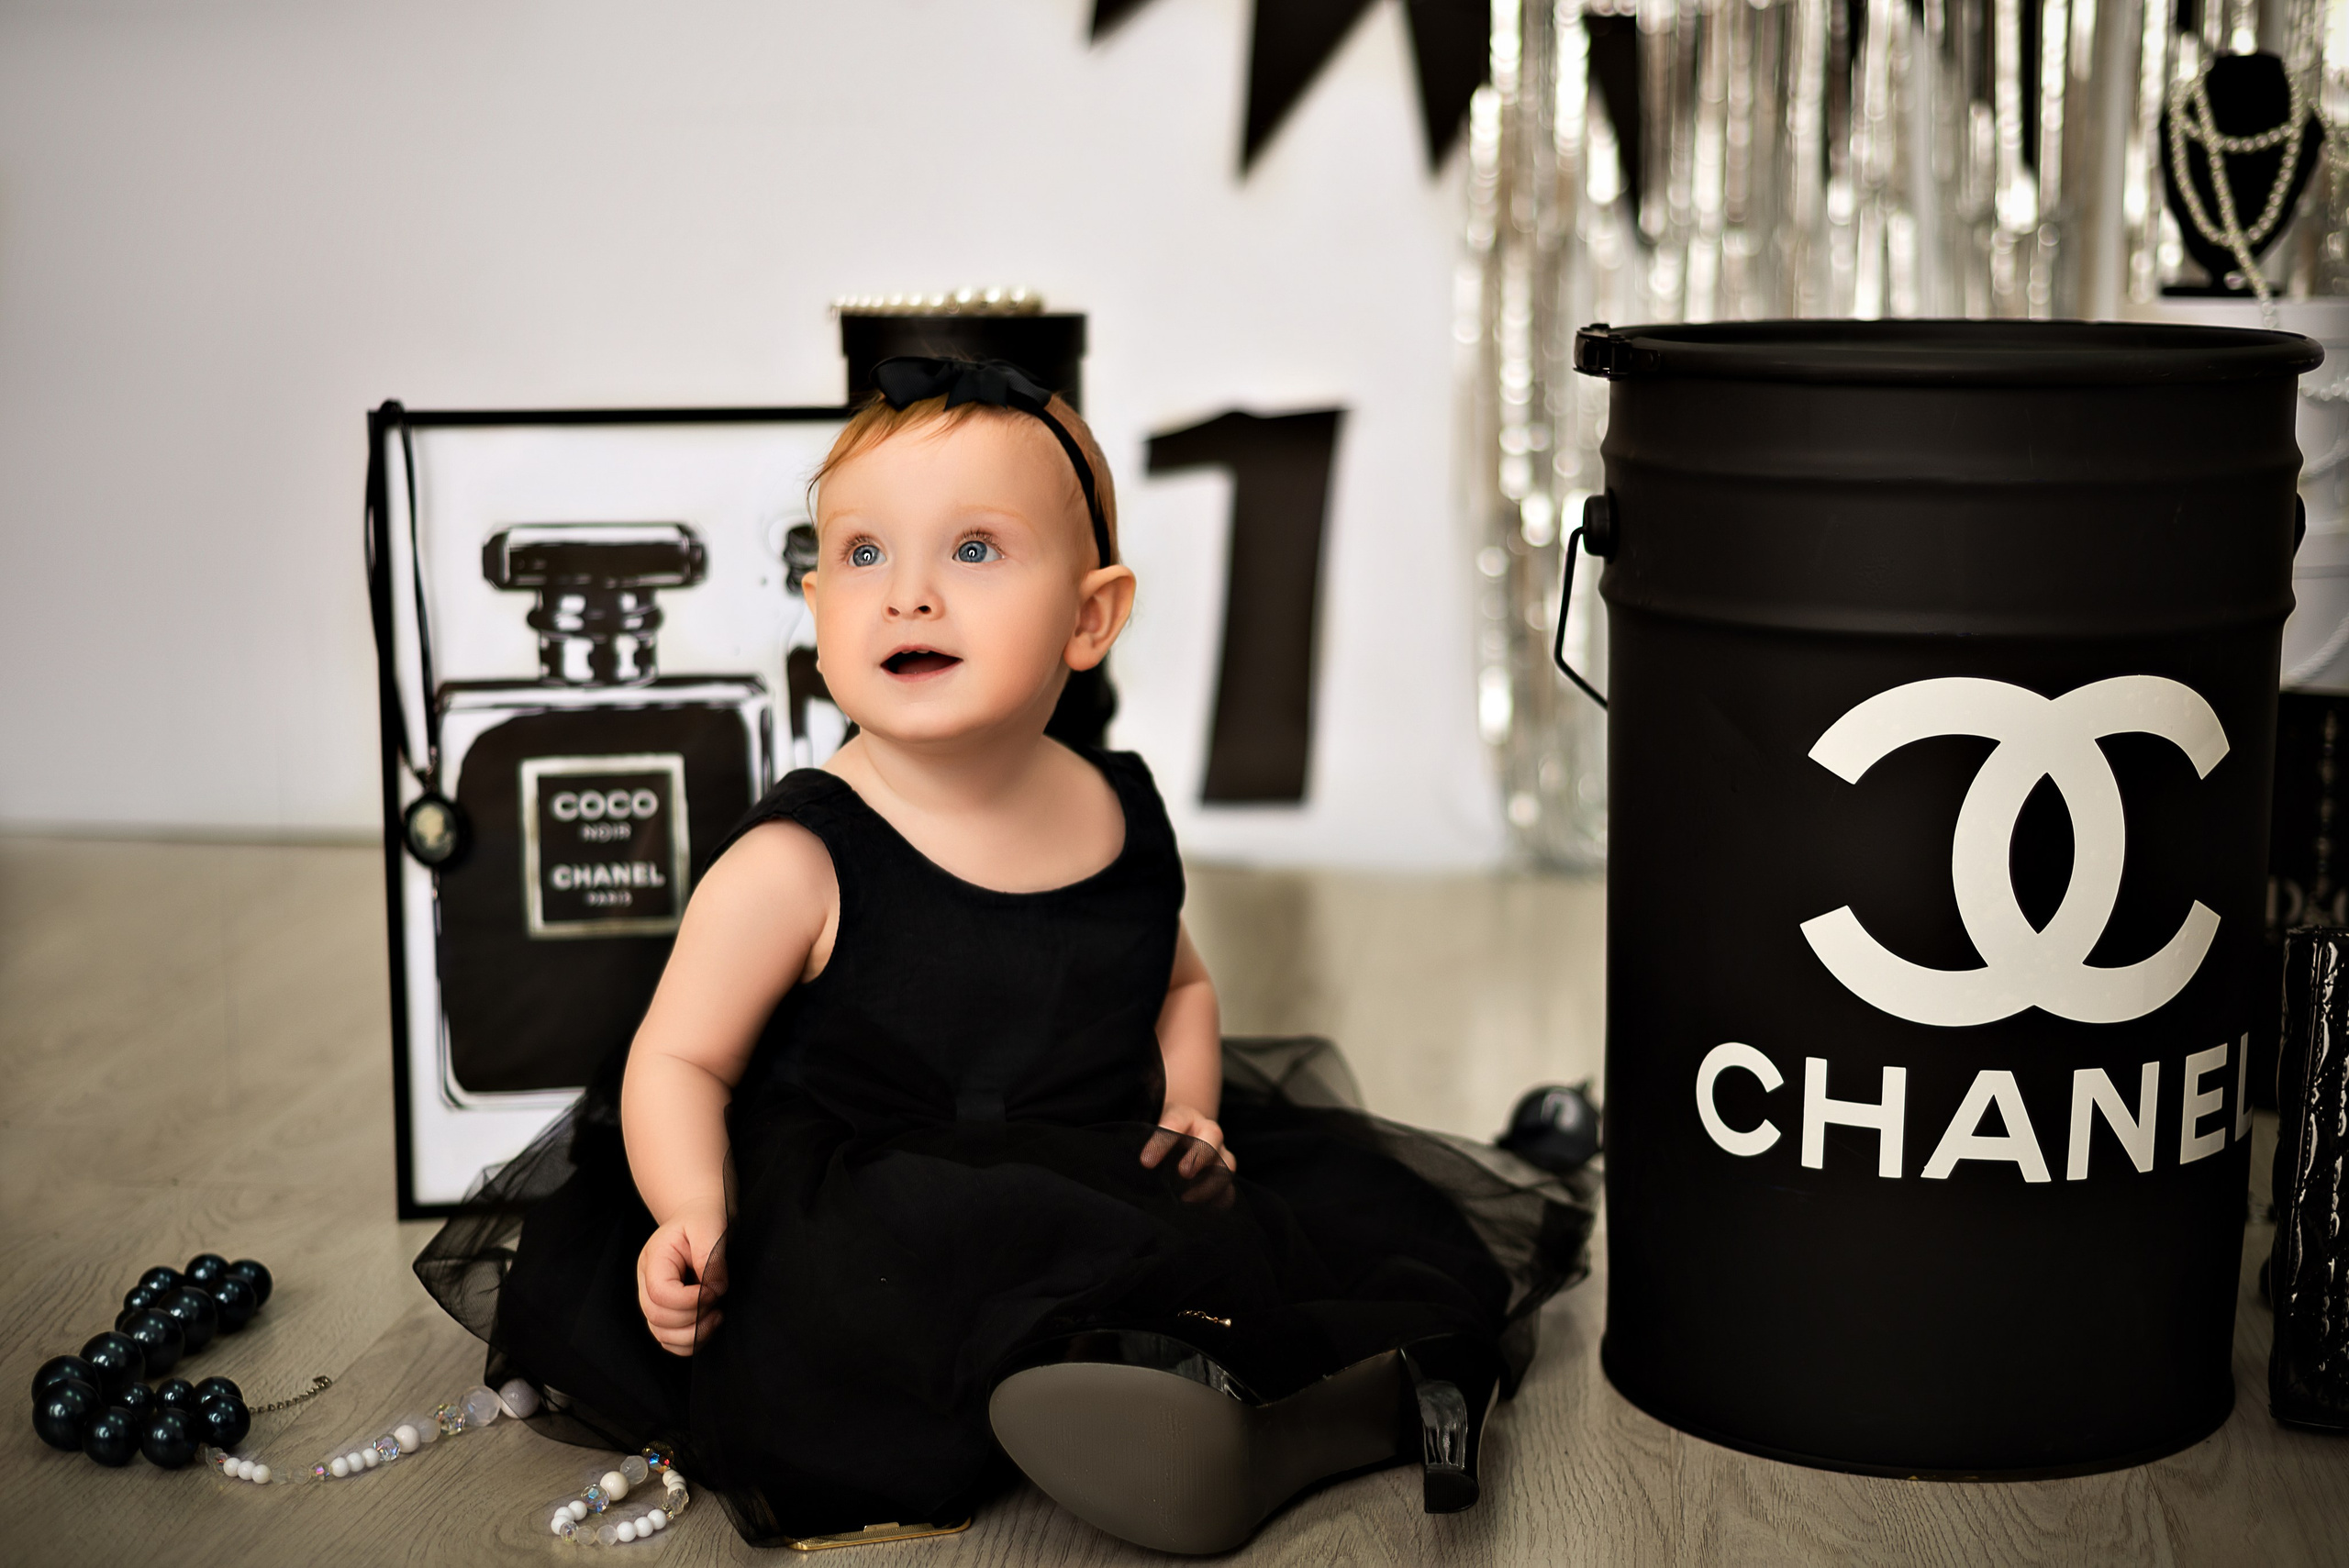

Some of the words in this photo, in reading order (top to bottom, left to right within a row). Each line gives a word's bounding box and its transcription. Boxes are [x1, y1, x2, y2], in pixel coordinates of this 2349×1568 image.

[1145, 408, 1349, 806] 1
[552, 790, 659, 821] COCO
[552, 862, 666, 890] CHANEL
[1696, 1032, 2254, 1183] CHANEL
